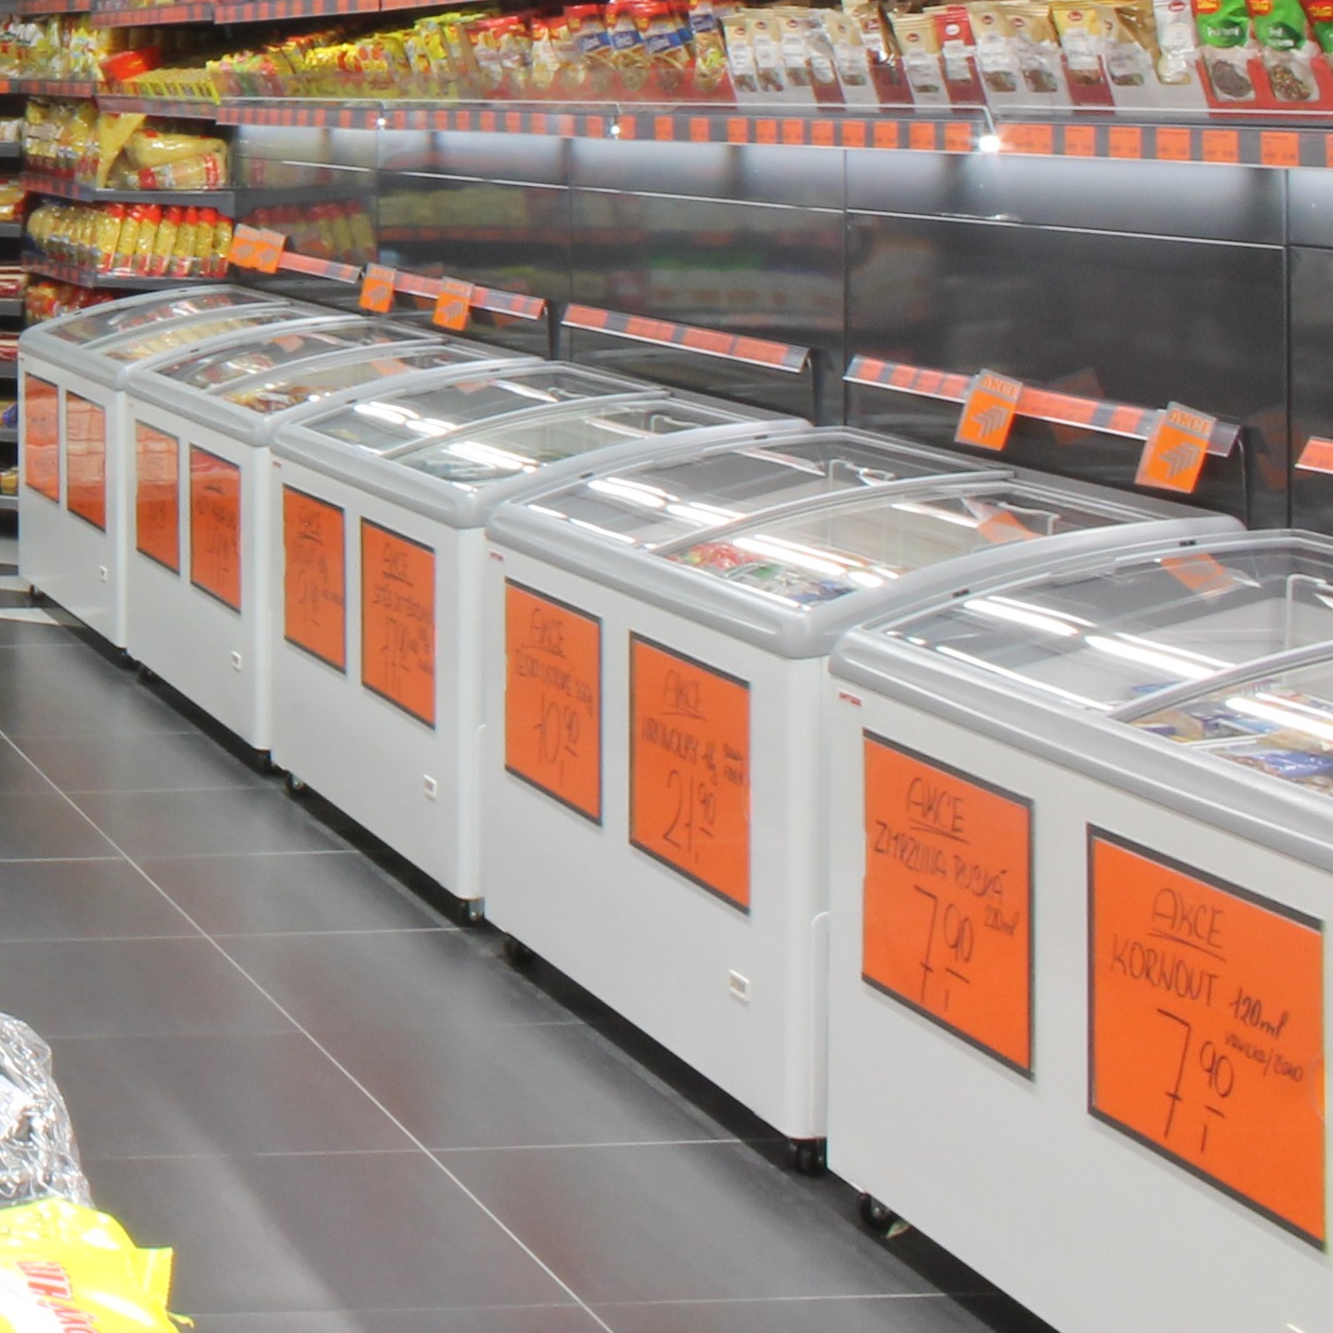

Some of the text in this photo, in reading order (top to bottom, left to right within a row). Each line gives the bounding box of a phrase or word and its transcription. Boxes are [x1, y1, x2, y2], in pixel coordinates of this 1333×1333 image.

[1168, 409, 1210, 434] AKCE
[906, 776, 965, 836] AKCE
[1152, 887, 1225, 949] AKCE
[1110, 933, 1221, 1006] KORNOUT
